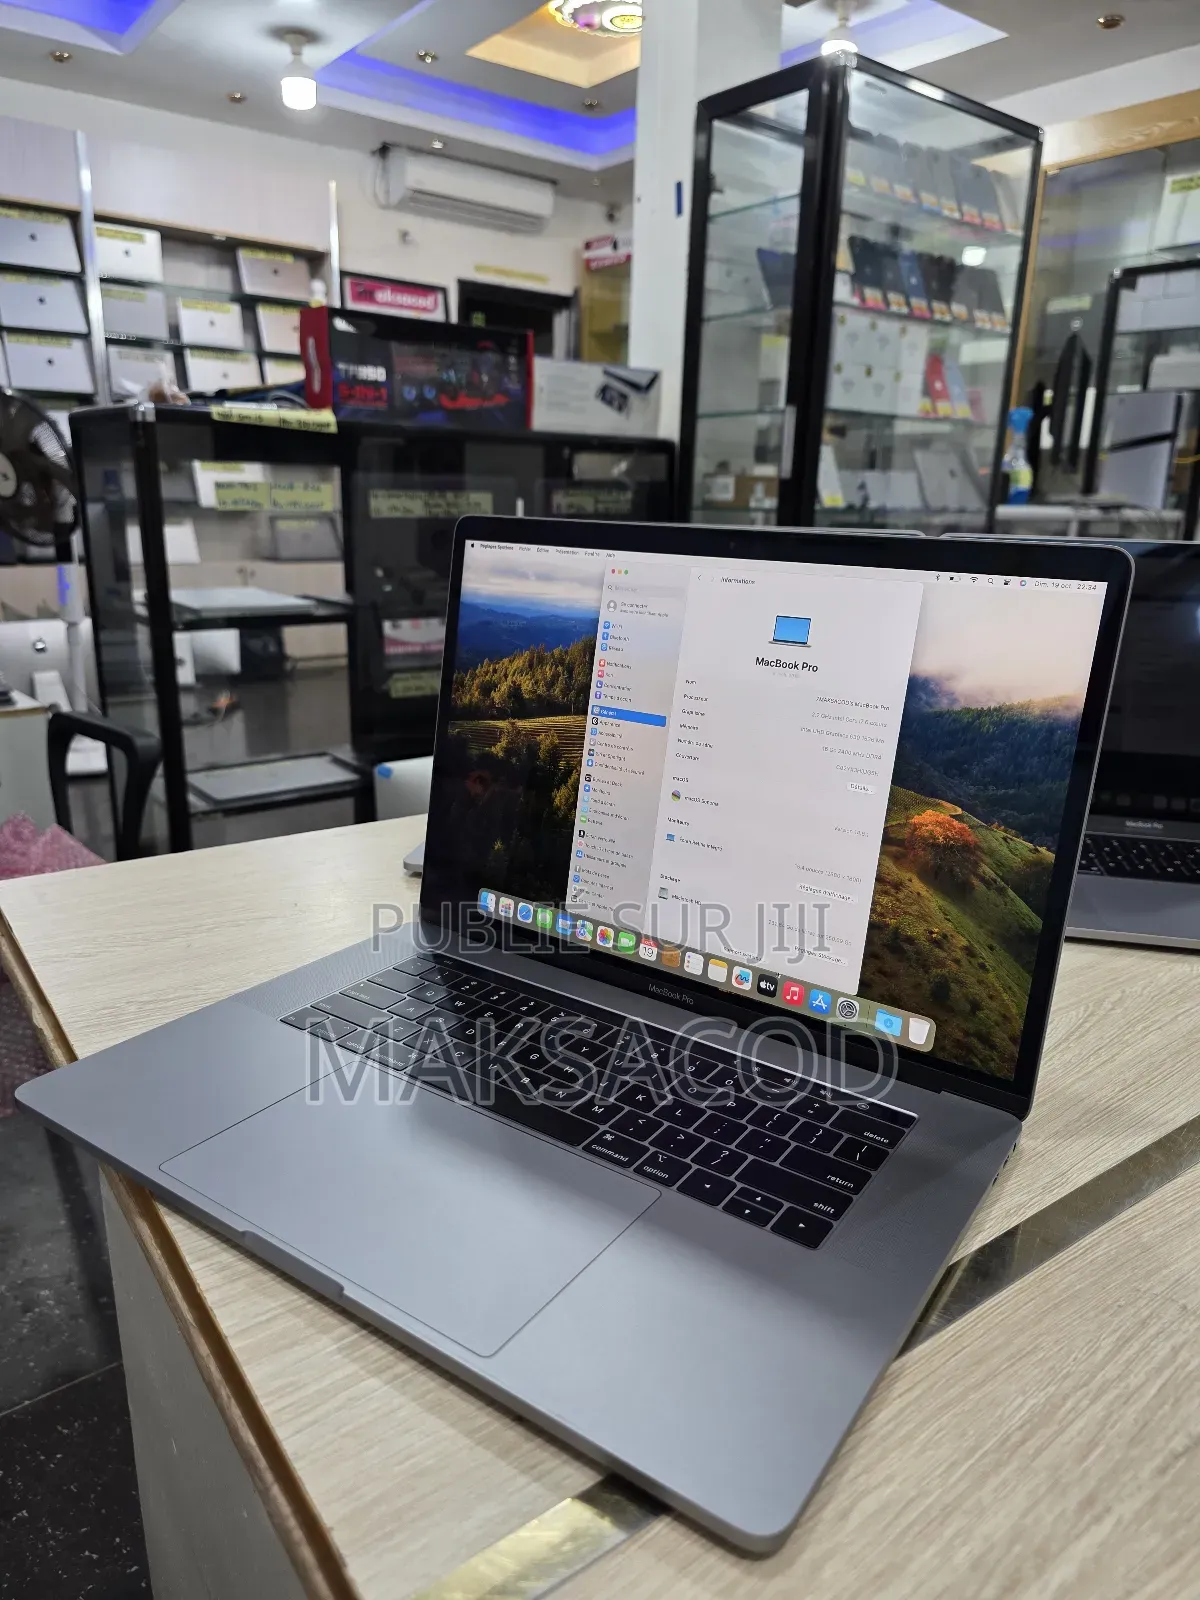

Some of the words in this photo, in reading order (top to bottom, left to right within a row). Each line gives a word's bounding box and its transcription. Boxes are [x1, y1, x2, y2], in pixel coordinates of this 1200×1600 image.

[755, 656, 799, 671] MacBook
[802, 662, 819, 673] Pro
[643, 946, 654, 958] 19
[765, 980, 775, 991] tv
[648, 983, 681, 1001] MacBook
[681, 994, 694, 1005] Pro
[591, 1105, 605, 1115] M
[864, 1130, 889, 1144] delete
[591, 1143, 629, 1162] command
[643, 1165, 669, 1180] option
[827, 1174, 854, 1188] return
[813, 1201, 835, 1214] shift
